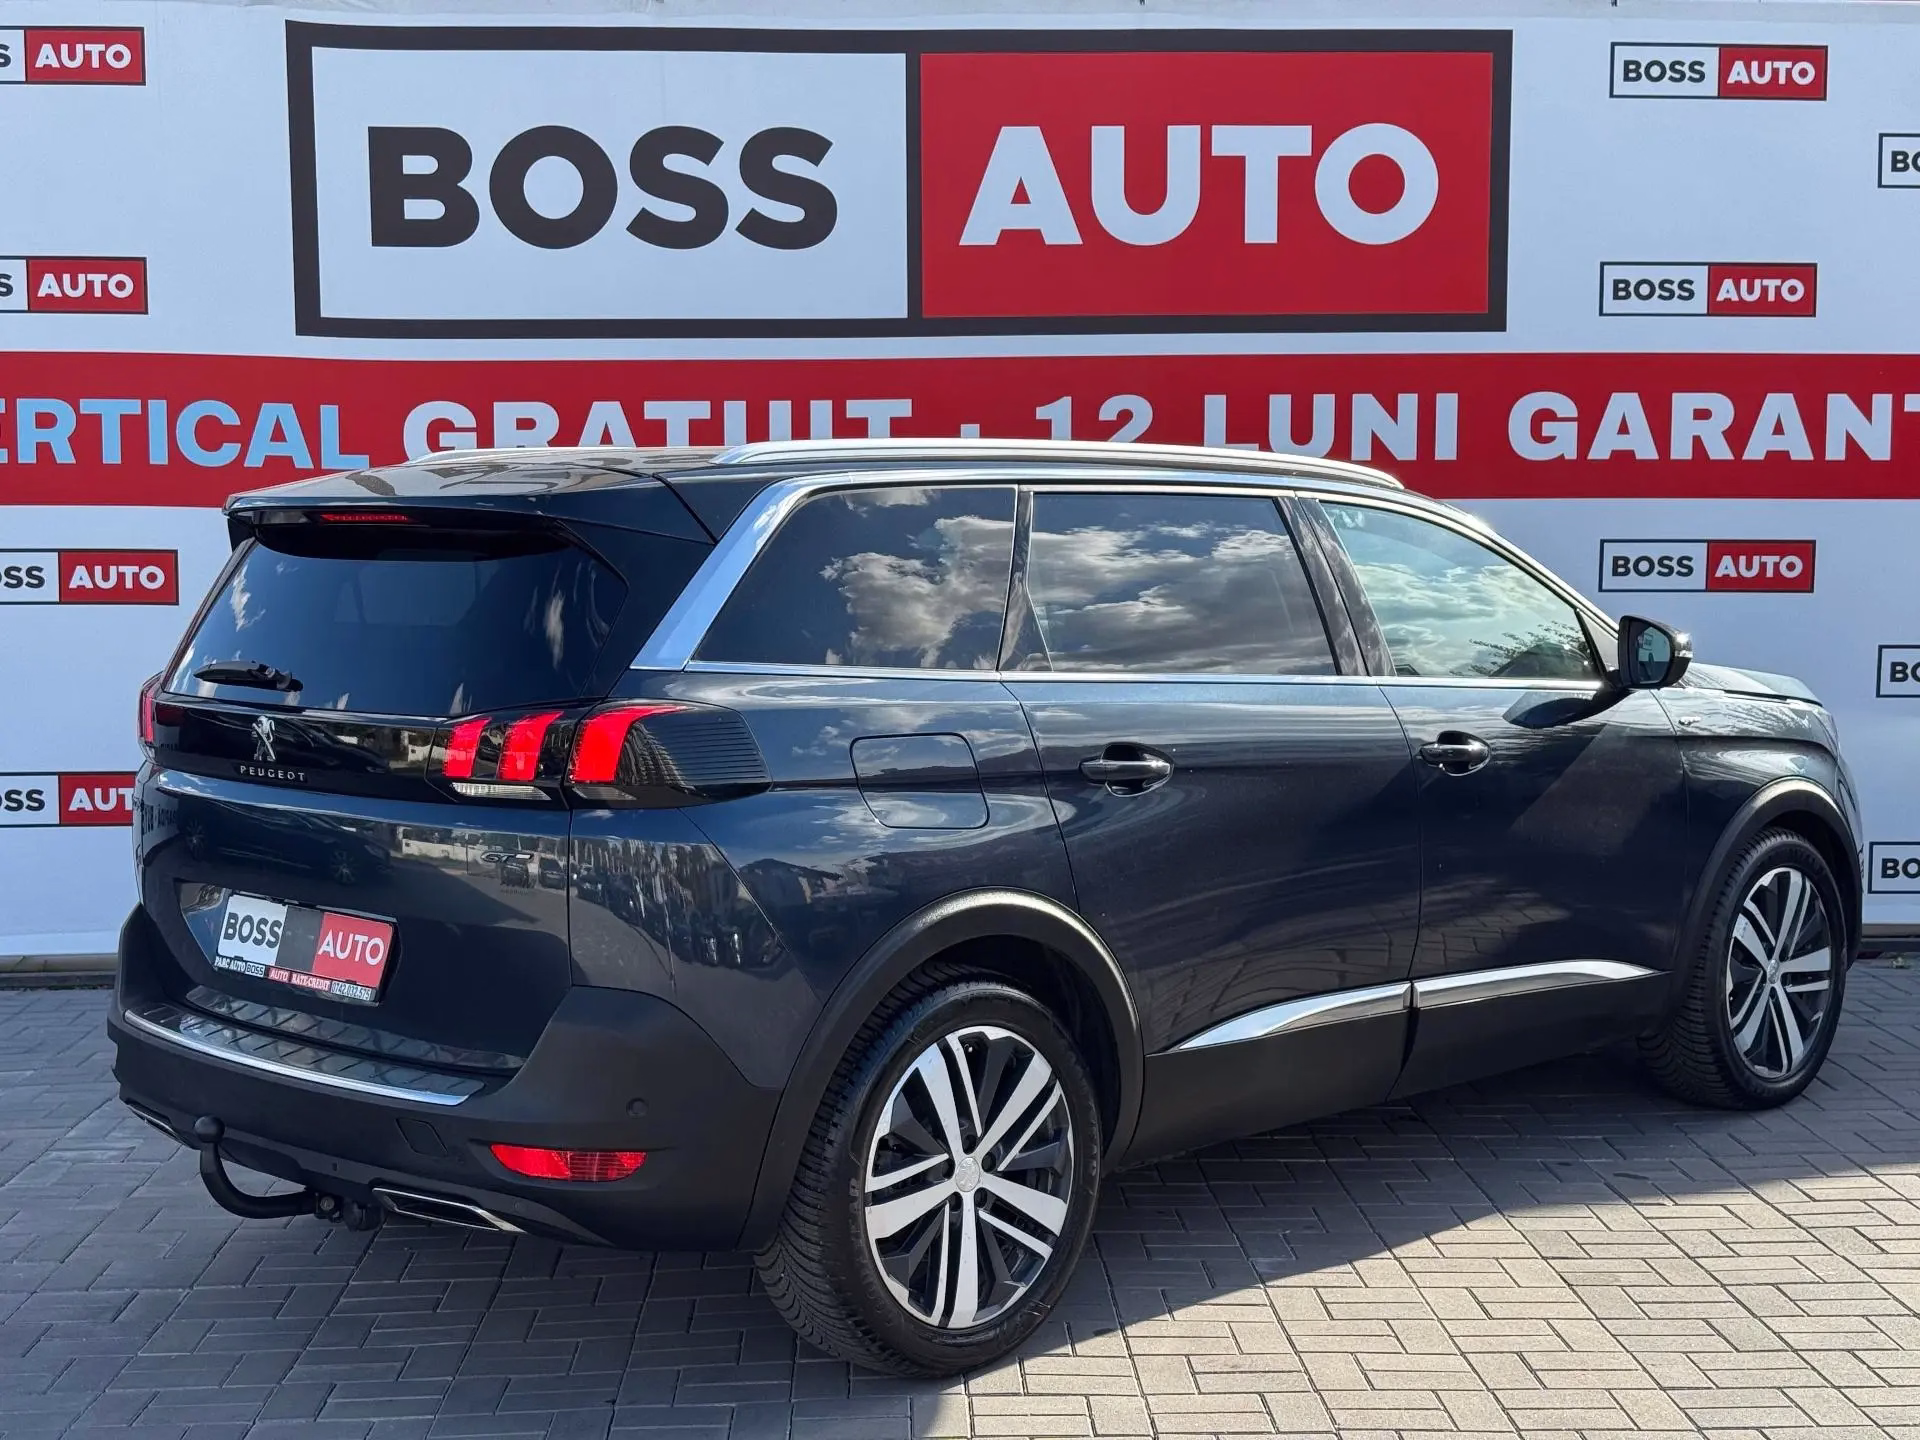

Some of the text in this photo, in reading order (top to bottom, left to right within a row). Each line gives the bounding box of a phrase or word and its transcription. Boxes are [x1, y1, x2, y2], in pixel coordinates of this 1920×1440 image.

[35, 43, 132, 69] AUTO
[1622, 60, 1816, 85] BOSS AUTO
[368, 123, 1439, 250] BOSS AUTO
[37, 273, 134, 299] AUTO
[1612, 279, 1804, 302] BOSS AUTO
[0, 397, 370, 470] RTICAL
[1036, 394, 1154, 443] 12
[1203, 393, 1458, 461] LUNI
[0, 565, 166, 589] SS AUTO
[1611, 555, 1804, 578] BOSS AUTO
[240, 765, 305, 781] PEUGEOT
[0, 787, 135, 812] SS AUT
[223, 912, 385, 966] BOSS AUTO
[214, 955, 230, 969] PARC
[229, 960, 246, 973] AUTO
[246, 963, 265, 976] BOSS
[270, 969, 290, 981] AUTO
